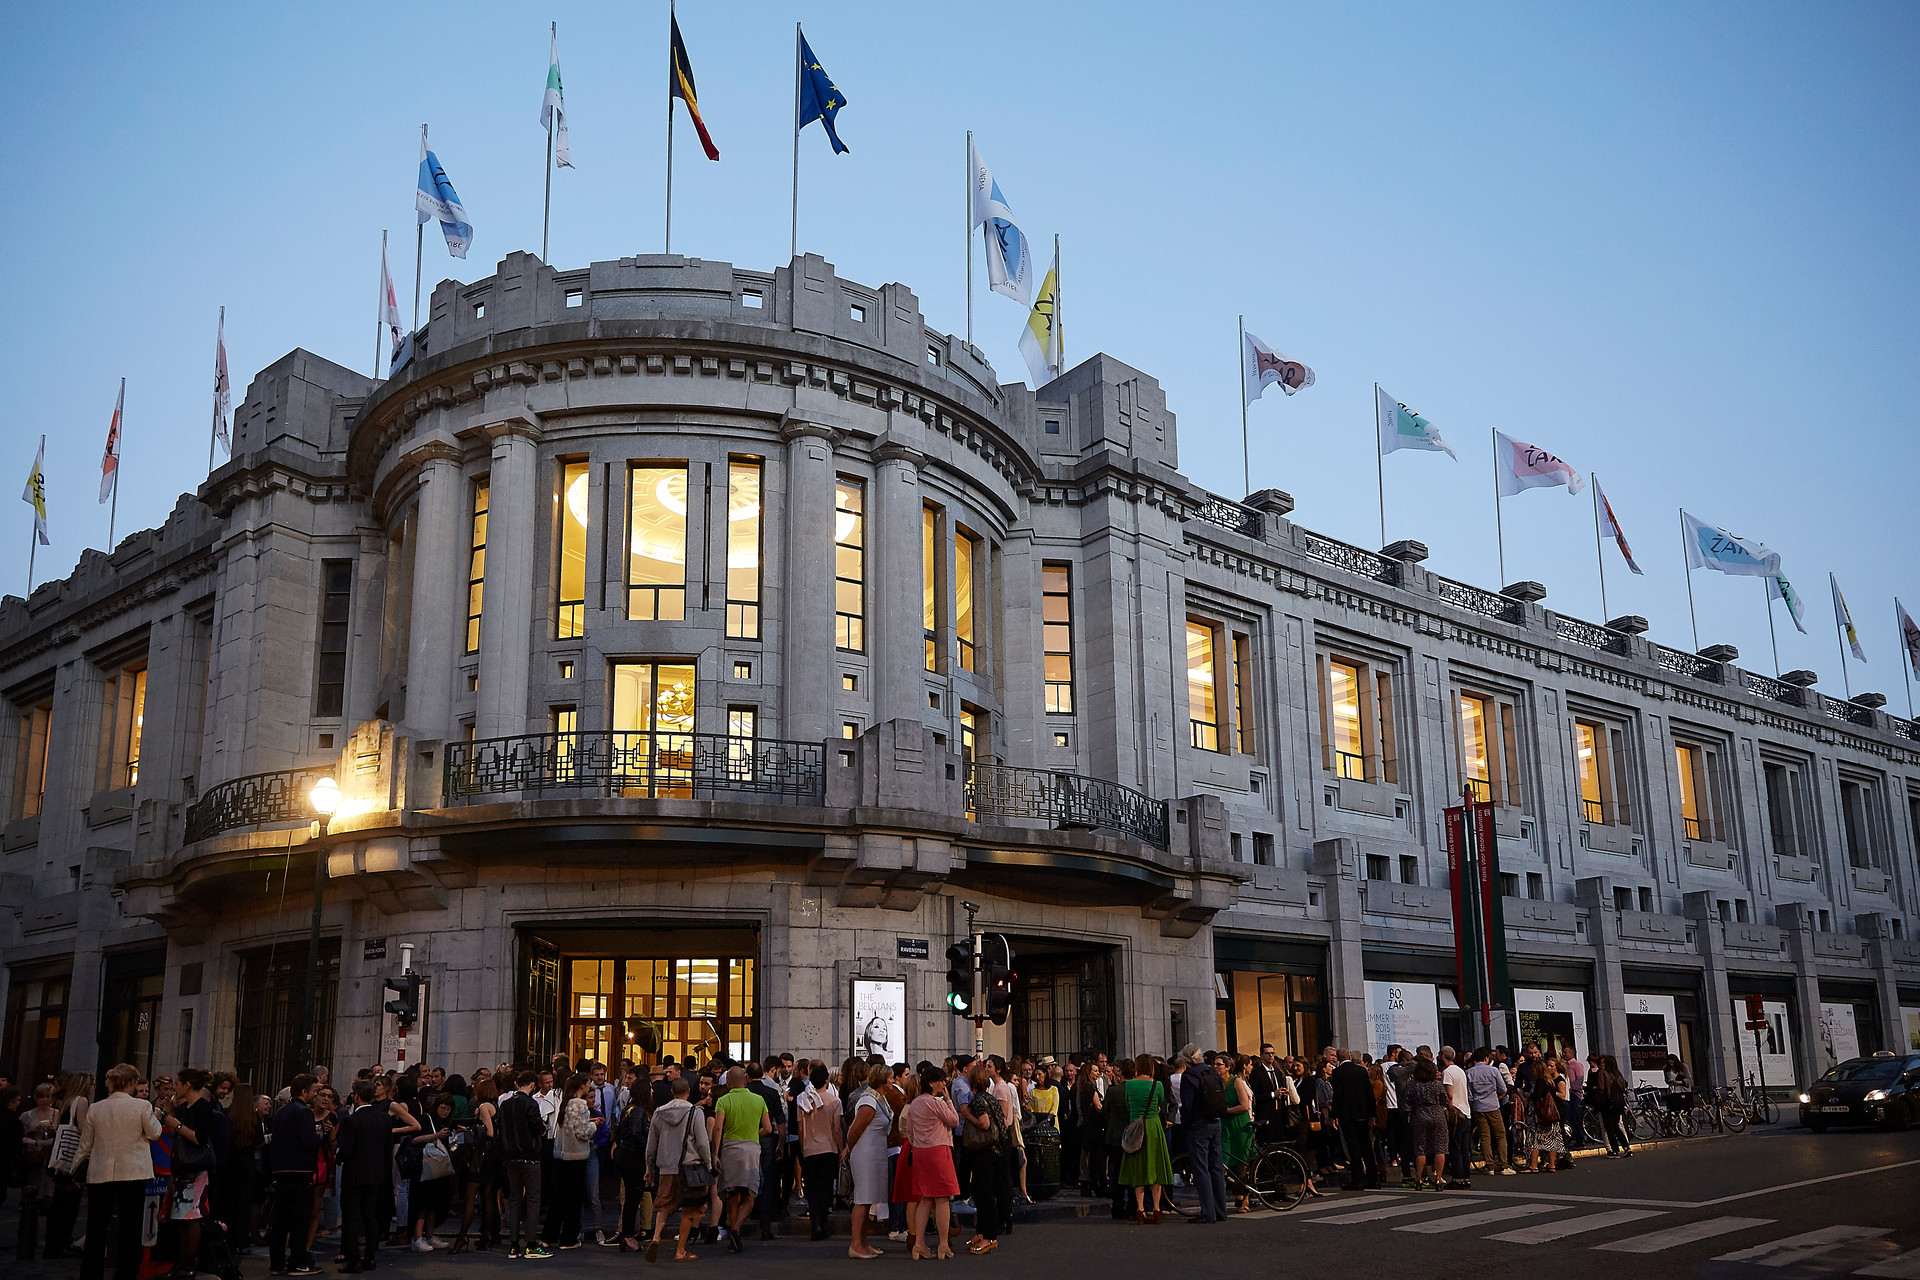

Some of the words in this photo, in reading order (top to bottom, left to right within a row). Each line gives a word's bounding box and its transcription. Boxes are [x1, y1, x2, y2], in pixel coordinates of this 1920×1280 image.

[860, 992, 874, 1002] THE
[1389, 988, 1402, 999] BO
[858, 1002, 897, 1011] BELGIANS
[1388, 1000, 1404, 1010] ZAR
[140, 1012, 148, 1022] BO
[1520, 1013, 1540, 1021] THEATER
[138, 1022, 148, 1032] ZAR
[1376, 1024, 1391, 1033] 2015
[1379, 1034, 1391, 1042] FREE
